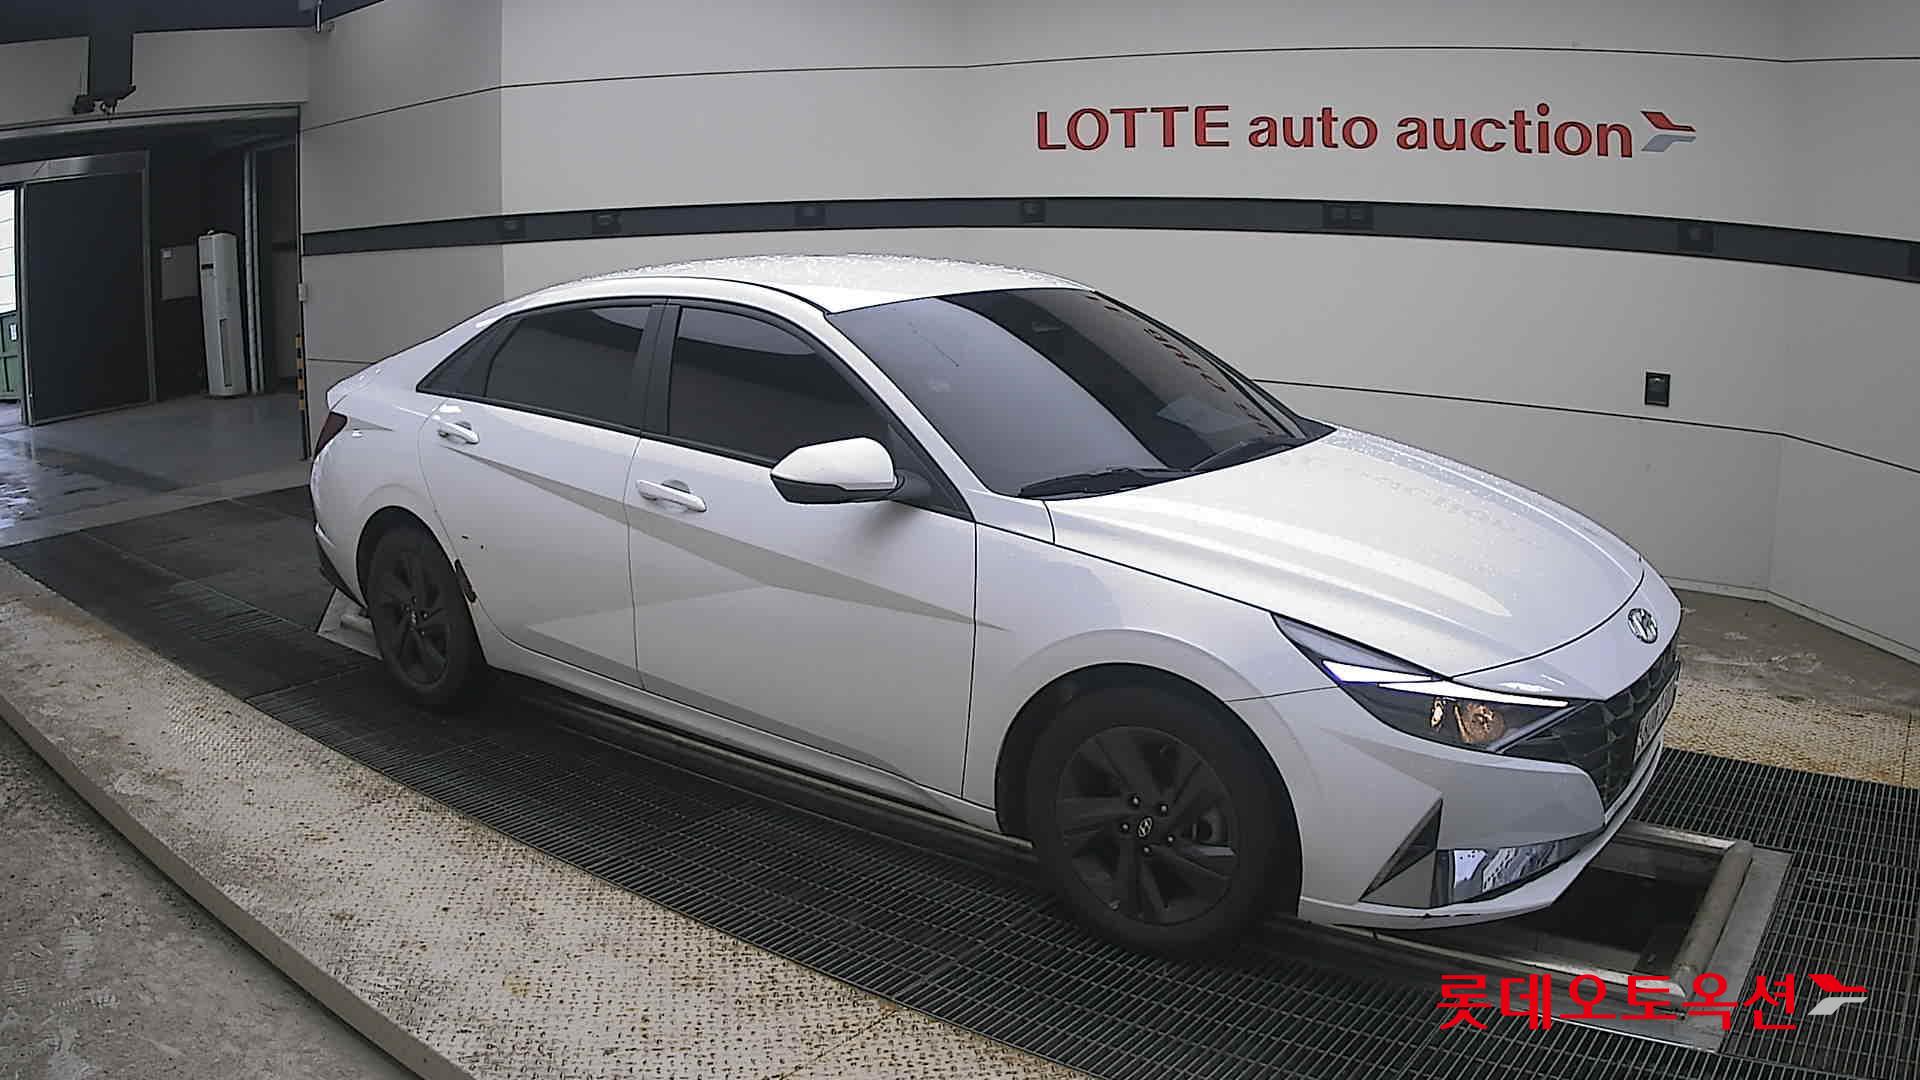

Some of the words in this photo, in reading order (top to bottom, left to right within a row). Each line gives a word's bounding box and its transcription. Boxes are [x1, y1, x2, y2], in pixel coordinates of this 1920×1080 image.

[1037, 105, 1230, 152] LOTTE
[1248, 107, 1379, 151] auto
[1397, 103, 1634, 158] auction
